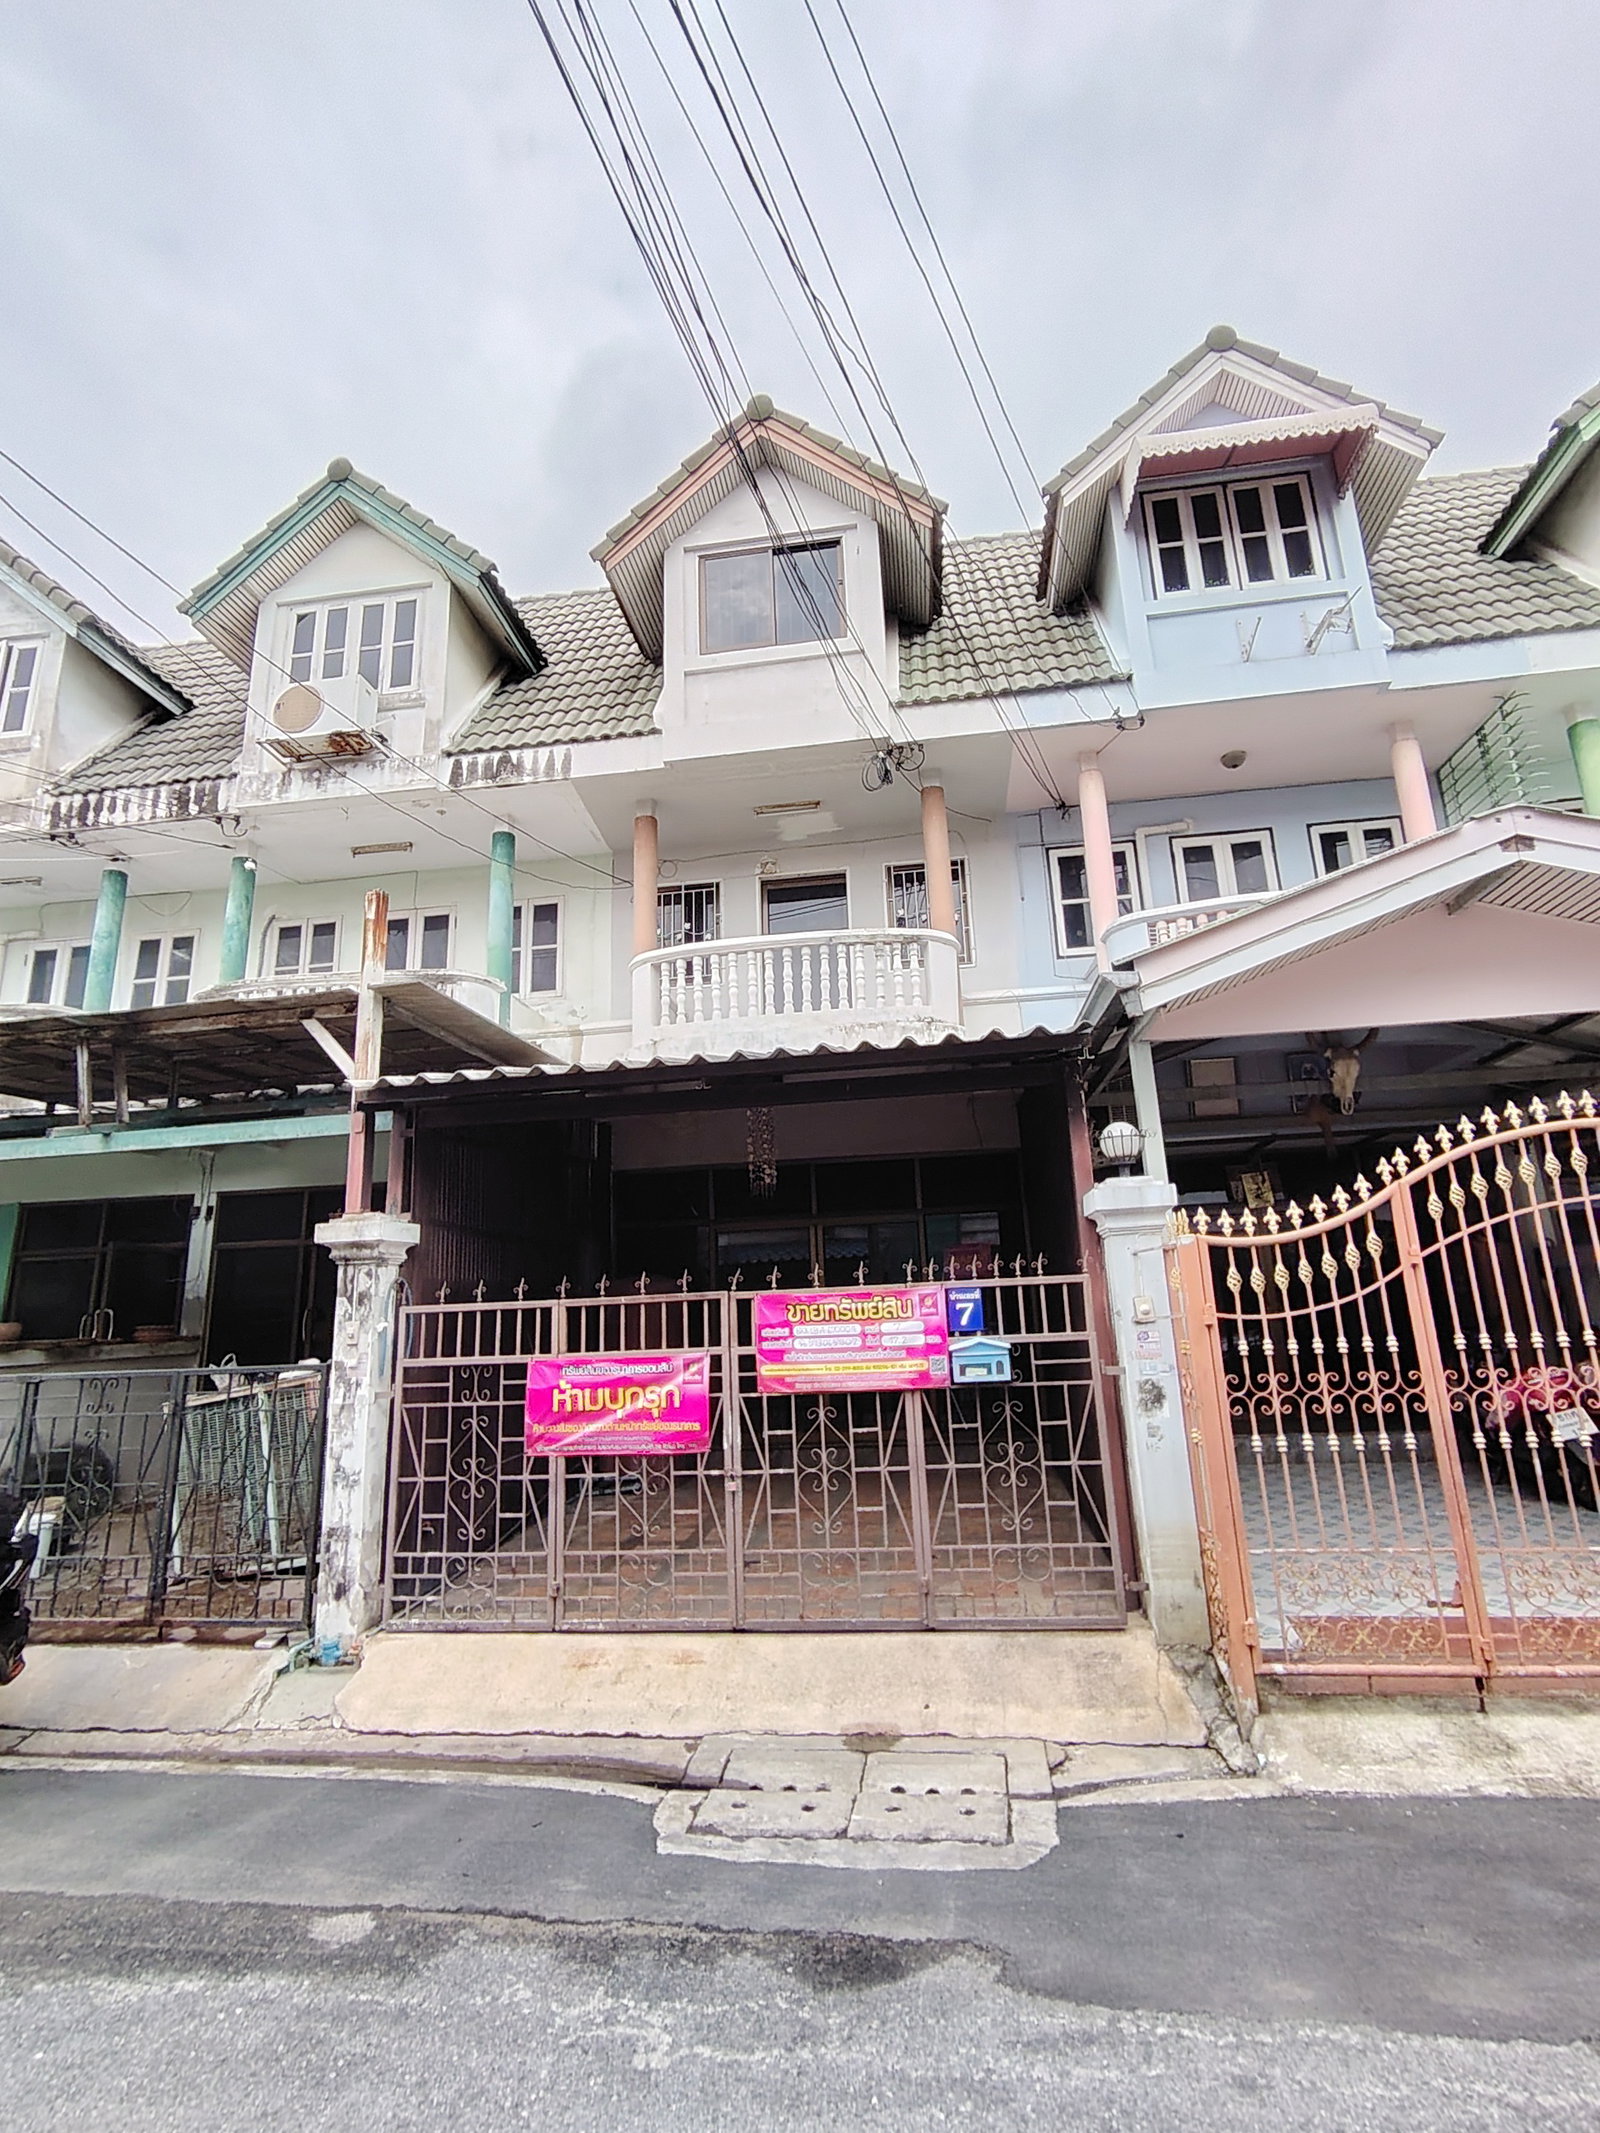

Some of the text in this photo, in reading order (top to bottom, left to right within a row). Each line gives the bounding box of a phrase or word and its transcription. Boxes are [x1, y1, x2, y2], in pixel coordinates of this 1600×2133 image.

[786, 1297, 914, 1323] ขายทรัพย์สิน
[955, 1302, 974, 1326] 7
[551, 1380, 682, 1419] ห้ามบุกรุก
